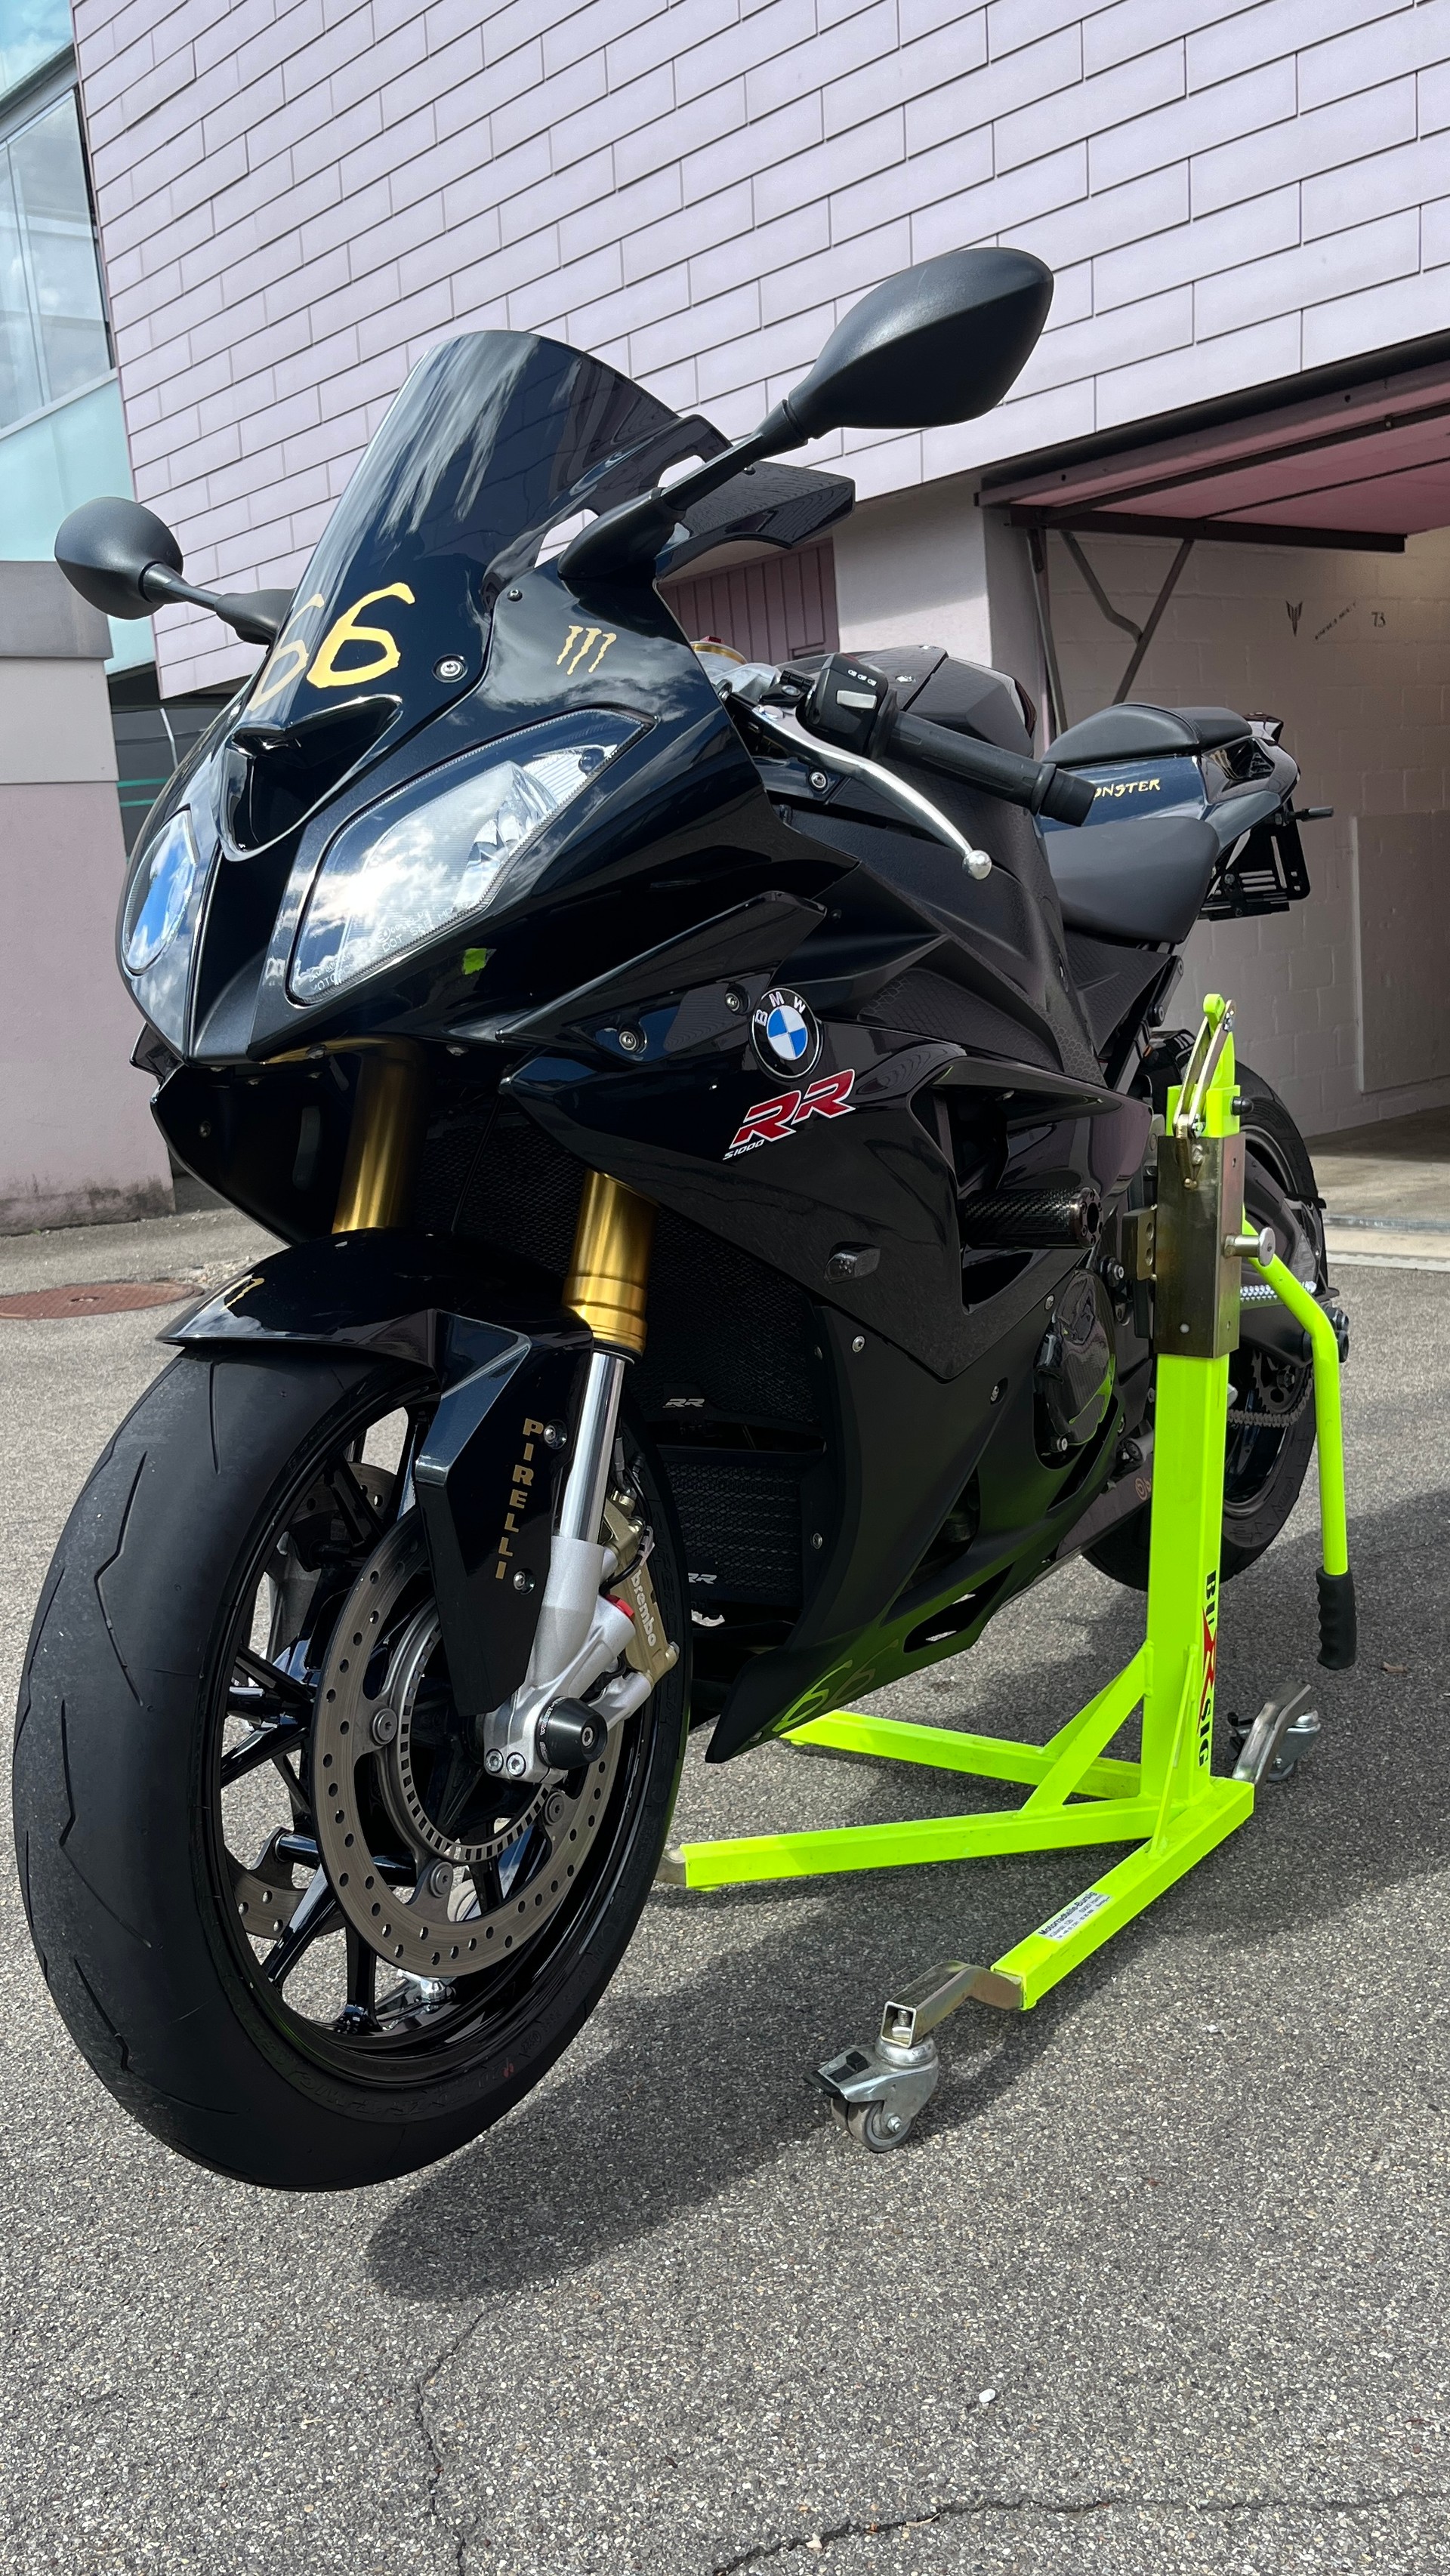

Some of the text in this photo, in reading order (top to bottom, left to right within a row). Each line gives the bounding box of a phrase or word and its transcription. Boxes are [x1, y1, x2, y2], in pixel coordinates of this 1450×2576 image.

[1094, 778, 1160, 799] ONSTER
[754, 991, 806, 1027] BMW
[729, 1068, 856, 1149] RR
[723, 1139, 764, 1160] S1000
[665, 1398, 705, 1408] RR
[495, 1418, 545, 1579] PIRELLI
[631, 1569, 657, 1647] brembo
